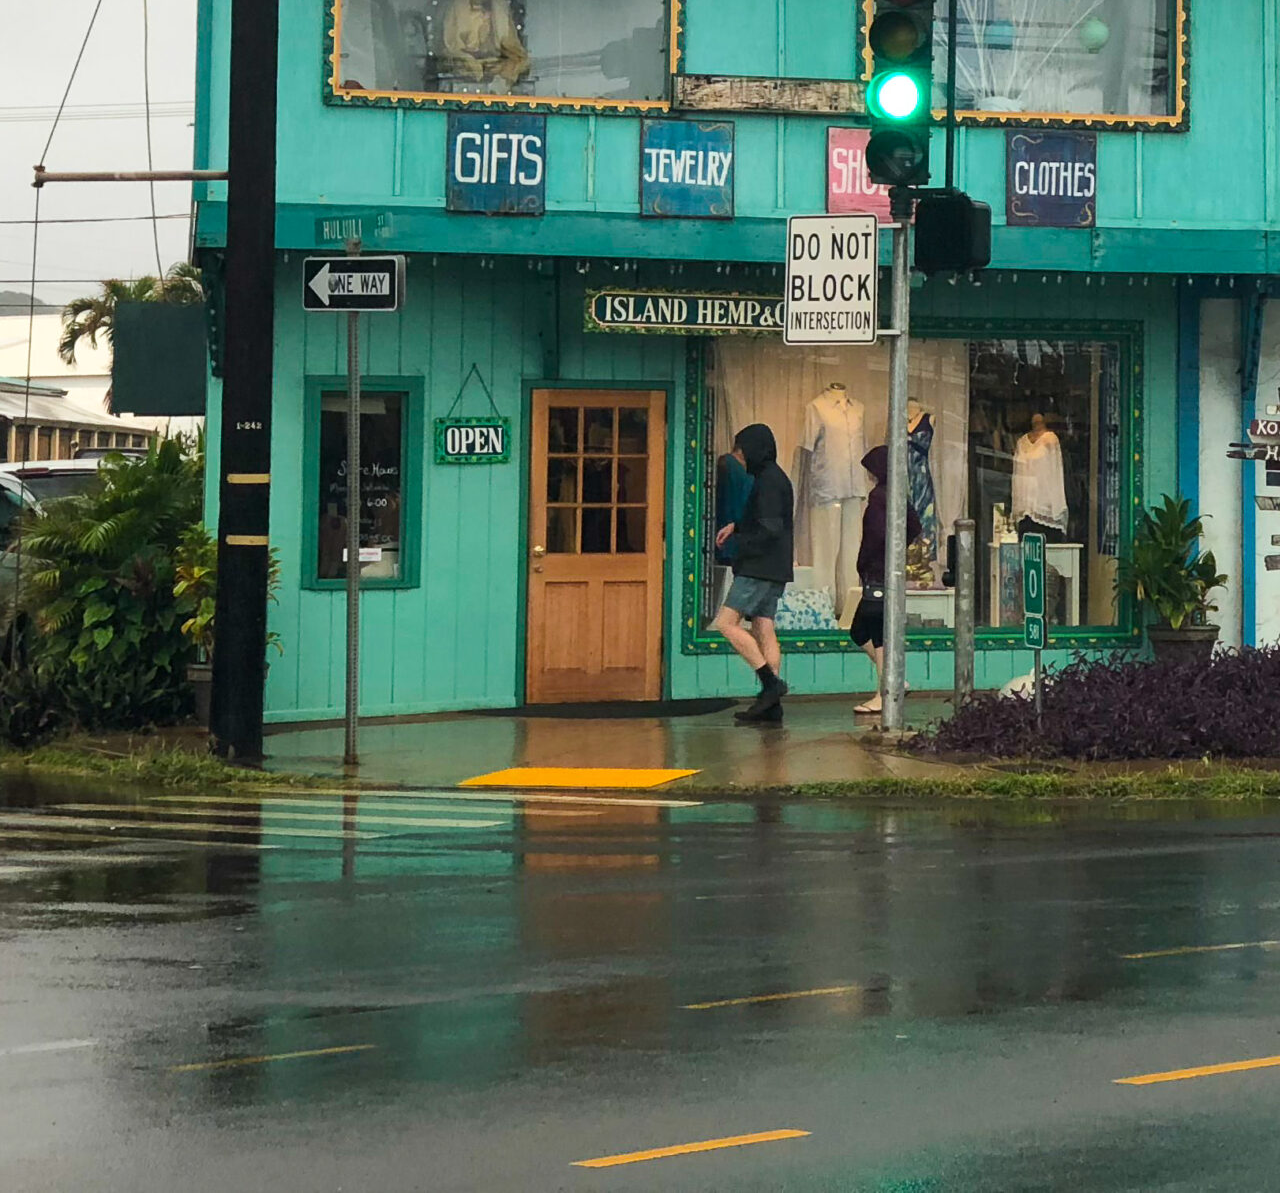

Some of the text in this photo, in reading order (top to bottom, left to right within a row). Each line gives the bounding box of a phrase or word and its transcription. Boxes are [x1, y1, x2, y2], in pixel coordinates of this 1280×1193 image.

[644, 149, 732, 187] JEWELRY
[1015, 161, 1095, 197] CLOTHES
[793, 232, 872, 260] DO NOT
[360, 274, 386, 293] WAY
[791, 274, 871, 302] BLOCK
[605, 296, 688, 323] ISLAND
[790, 311, 870, 330] INTERSECTION
[447, 427, 503, 454] OPEN
[1024, 541, 1041, 563] MILE
[1029, 569, 1037, 598] 0
